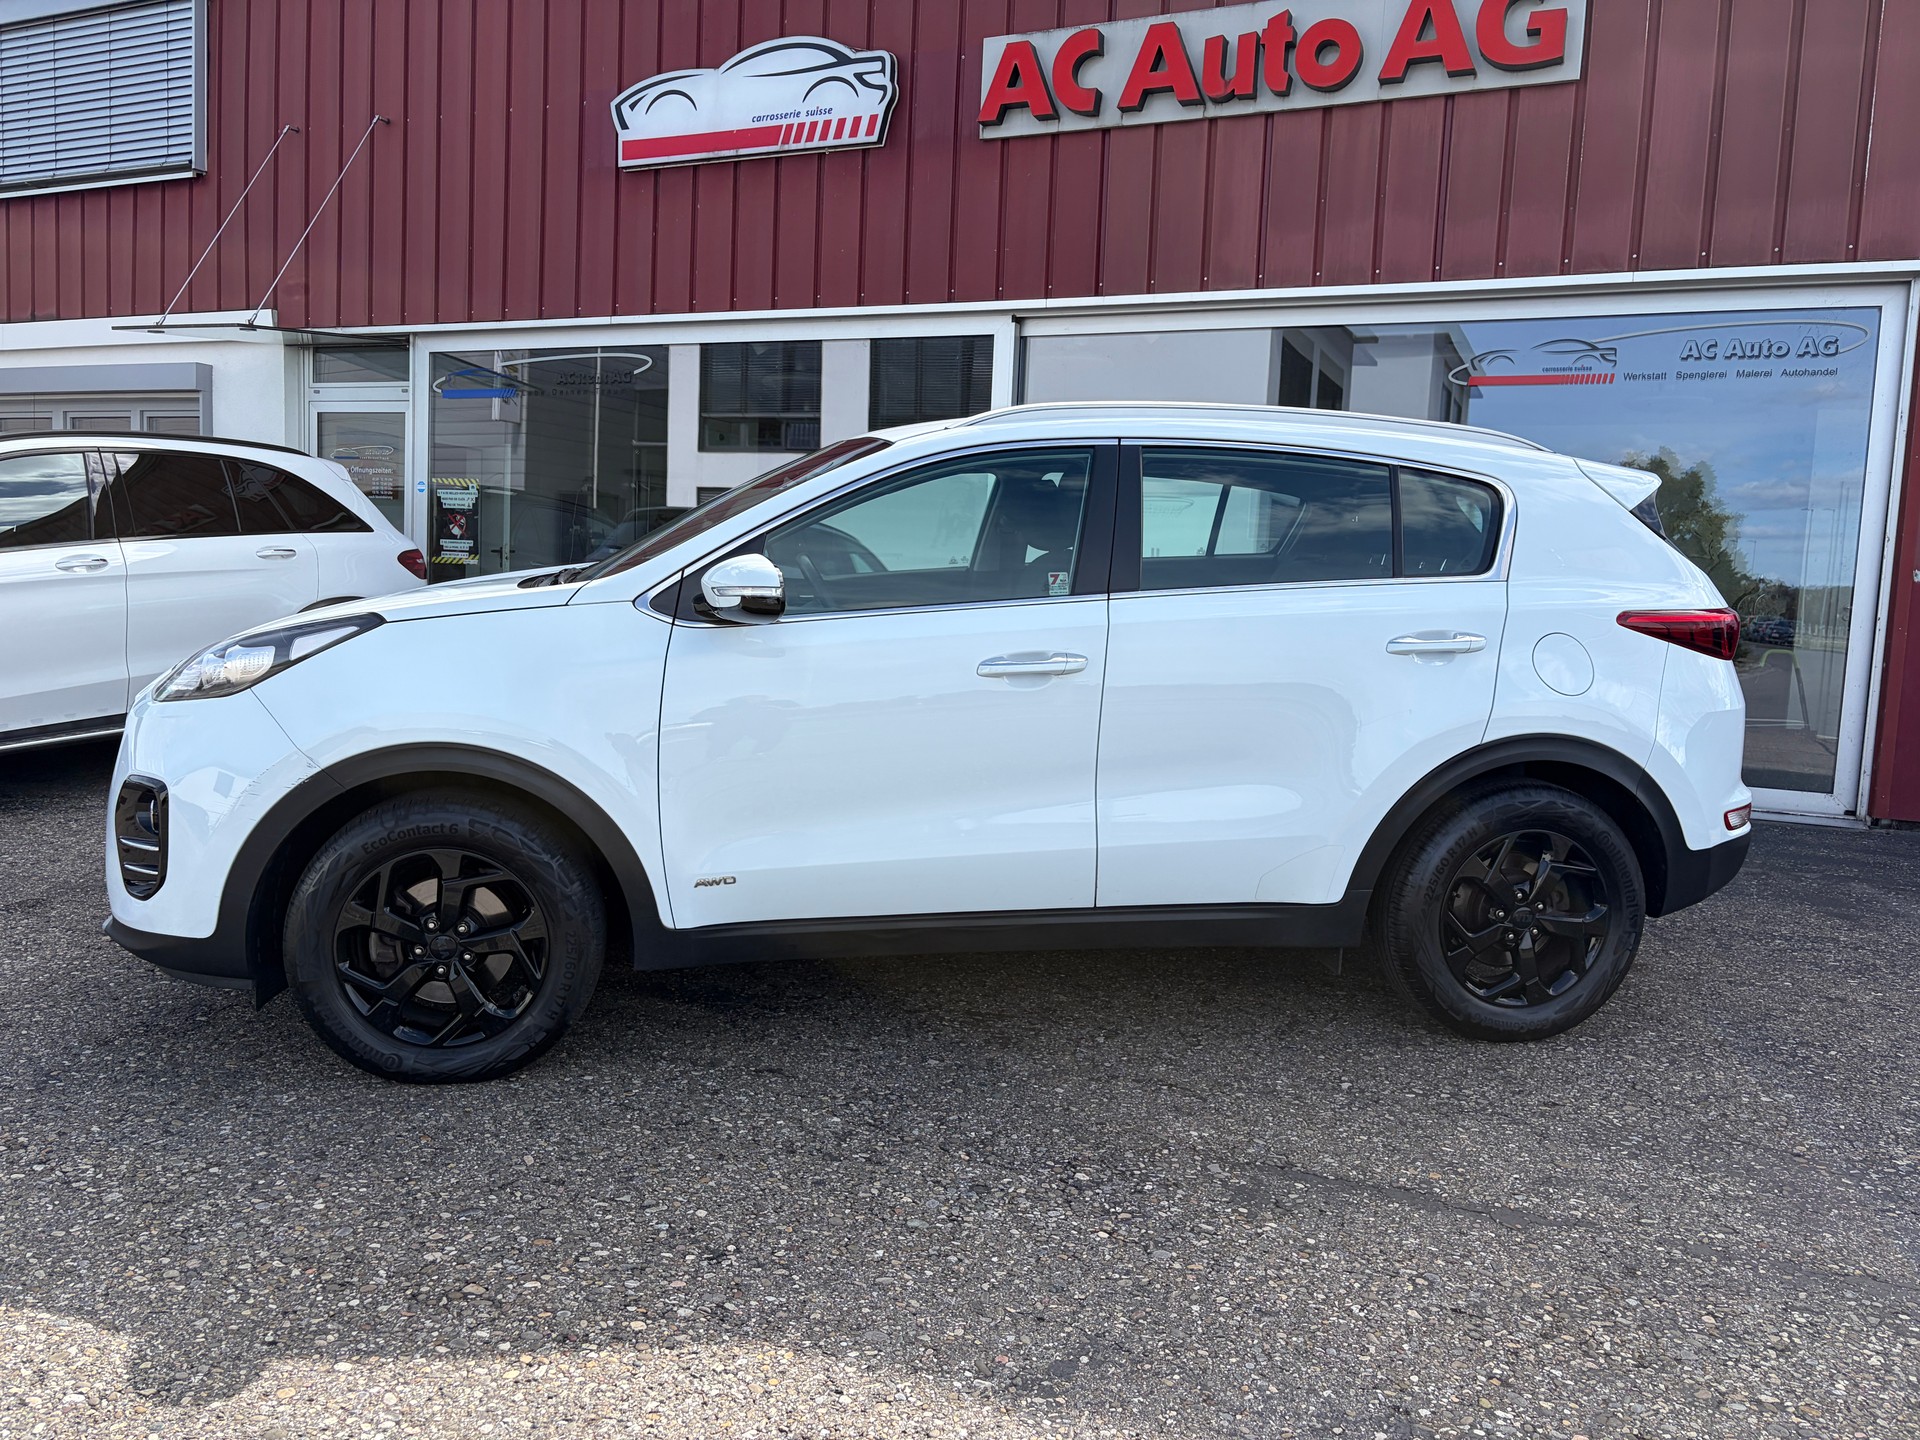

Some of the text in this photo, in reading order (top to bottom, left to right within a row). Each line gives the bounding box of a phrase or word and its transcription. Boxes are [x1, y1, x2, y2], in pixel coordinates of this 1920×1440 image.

[978, 0, 1568, 125] AC Auto AG
[752, 106, 833, 123] carrosserie suisse
[1679, 335, 1839, 361] AC Auto AG
[1574, 364, 1592, 372] suisse
[1623, 367, 1838, 381] Werkstatt Spenglerei Malerei Autohandel
[350, 465, 393, 475] Öffnungszeiten:
[1050, 573, 1060, 586] 7
[360, 823, 459, 854] EcoContact 6
[1423, 827, 1478, 902] 225/60 R 17 H
[1596, 831, 1639, 909] Continental
[694, 876, 736, 888] AWD
[562, 930, 577, 980] 225/60
[554, 994, 567, 1008] 17
